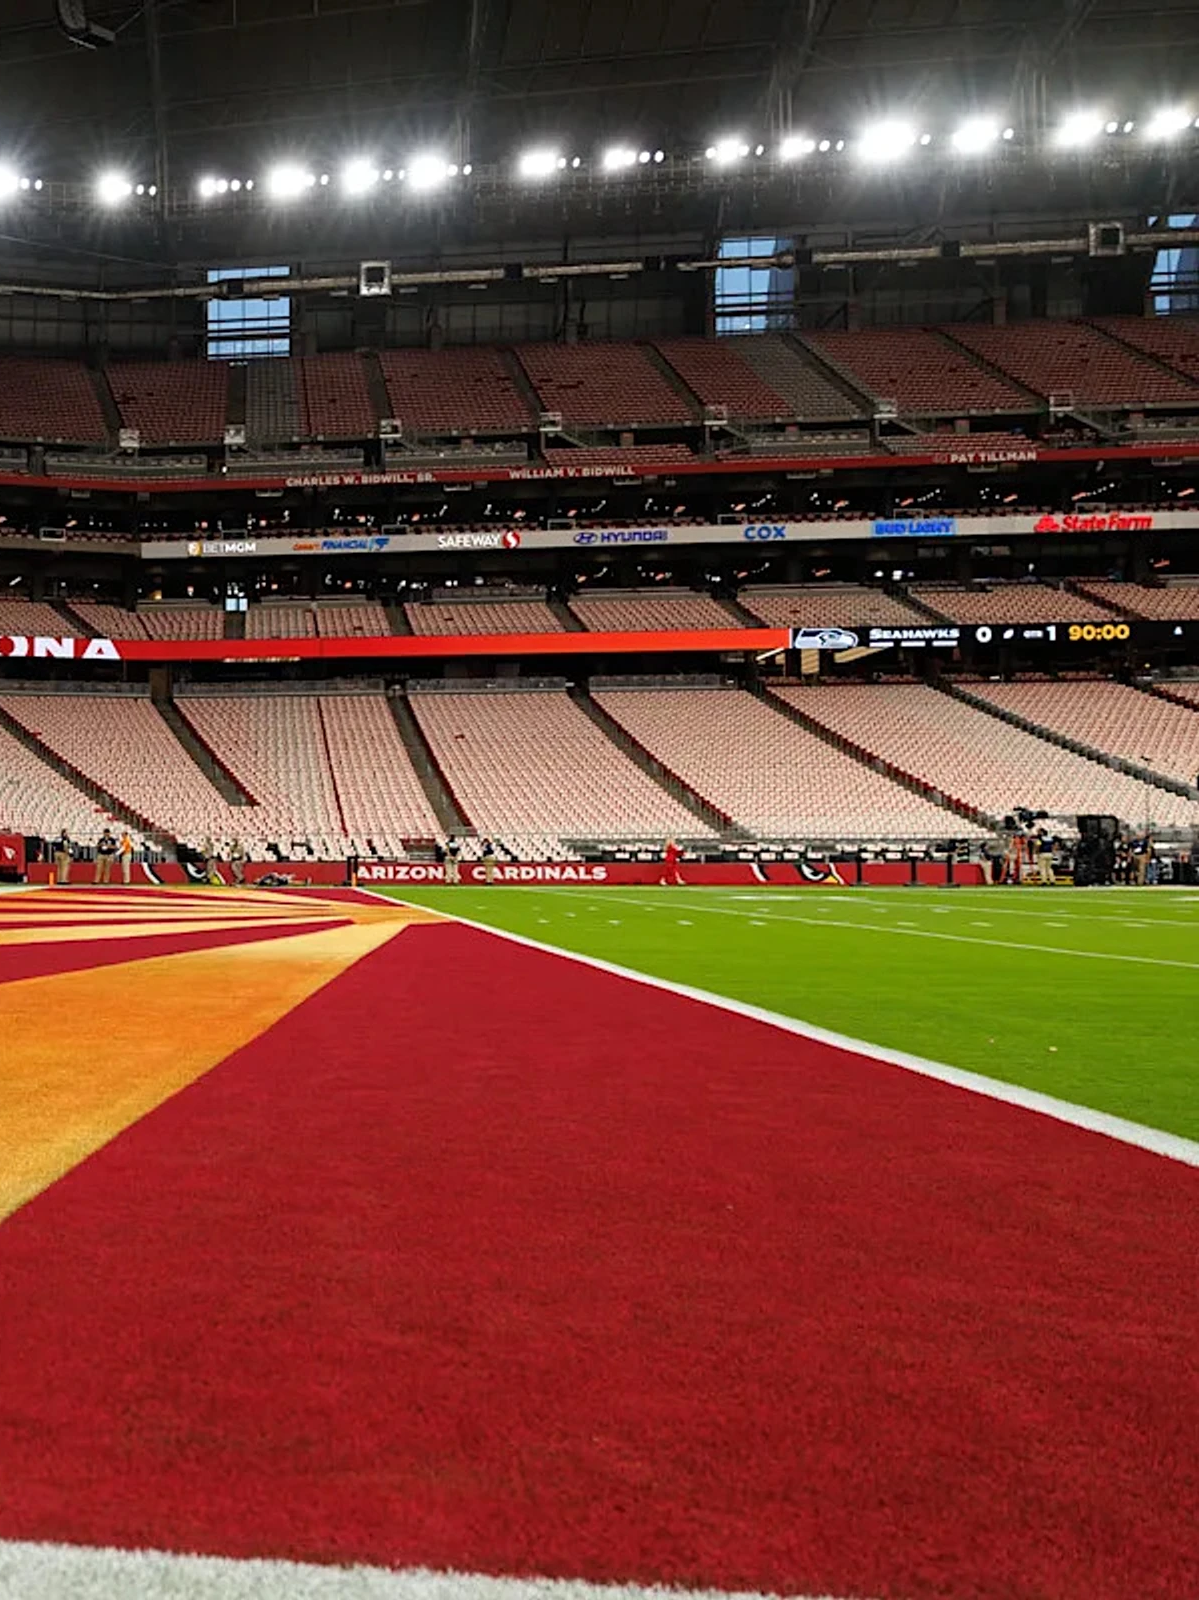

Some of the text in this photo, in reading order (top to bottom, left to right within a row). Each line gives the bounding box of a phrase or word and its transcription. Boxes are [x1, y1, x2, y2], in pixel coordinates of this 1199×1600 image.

[951, 453, 976, 463] PAT
[980, 451, 1036, 462] TILLMAN
[509, 465, 635, 479] WILLIAM V. BIDWILL
[286, 476, 341, 487] CHARLES
[343, 475, 359, 485] W.
[417, 474, 436, 482] SR.
[875, 523, 906, 535] BUD
[1062, 514, 1153, 530] State Farm
[601, 531, 668, 542] HYUNDAI
[744, 526, 786, 540] COX
[437, 533, 500, 549] SAFEWAY
[975, 626, 992, 643] 0
[1046, 625, 1056, 641] 1
[1068, 624, 1130, 641] 90:00
[472, 866, 607, 881] CARDINALS
